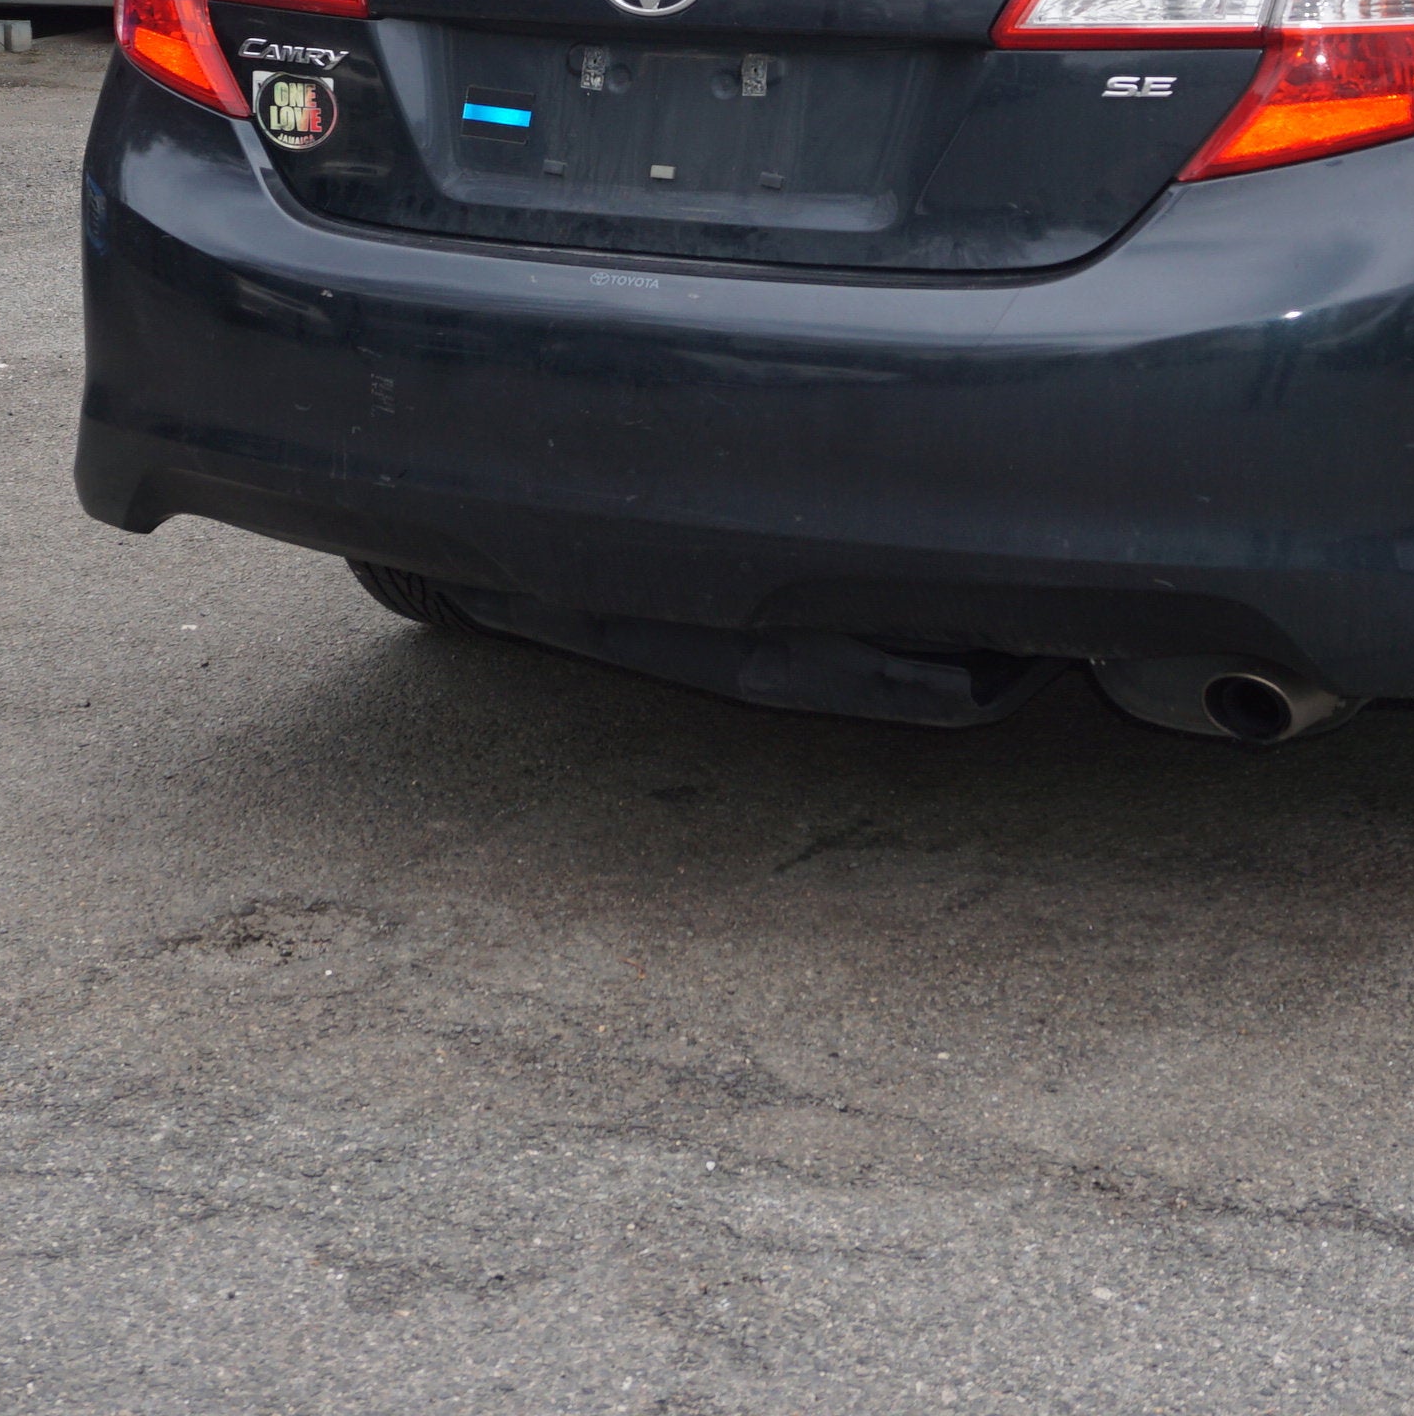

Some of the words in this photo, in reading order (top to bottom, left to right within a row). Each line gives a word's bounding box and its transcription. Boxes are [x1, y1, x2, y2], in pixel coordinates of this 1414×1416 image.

[238, 38, 349, 70] CAMRY
[274, 81, 317, 107] ONE
[1101, 76, 1178, 98] SE
[269, 105, 322, 133] LOVE
[277, 132, 315, 145] JAMAICA
[611, 274, 660, 289] TOYOTA
